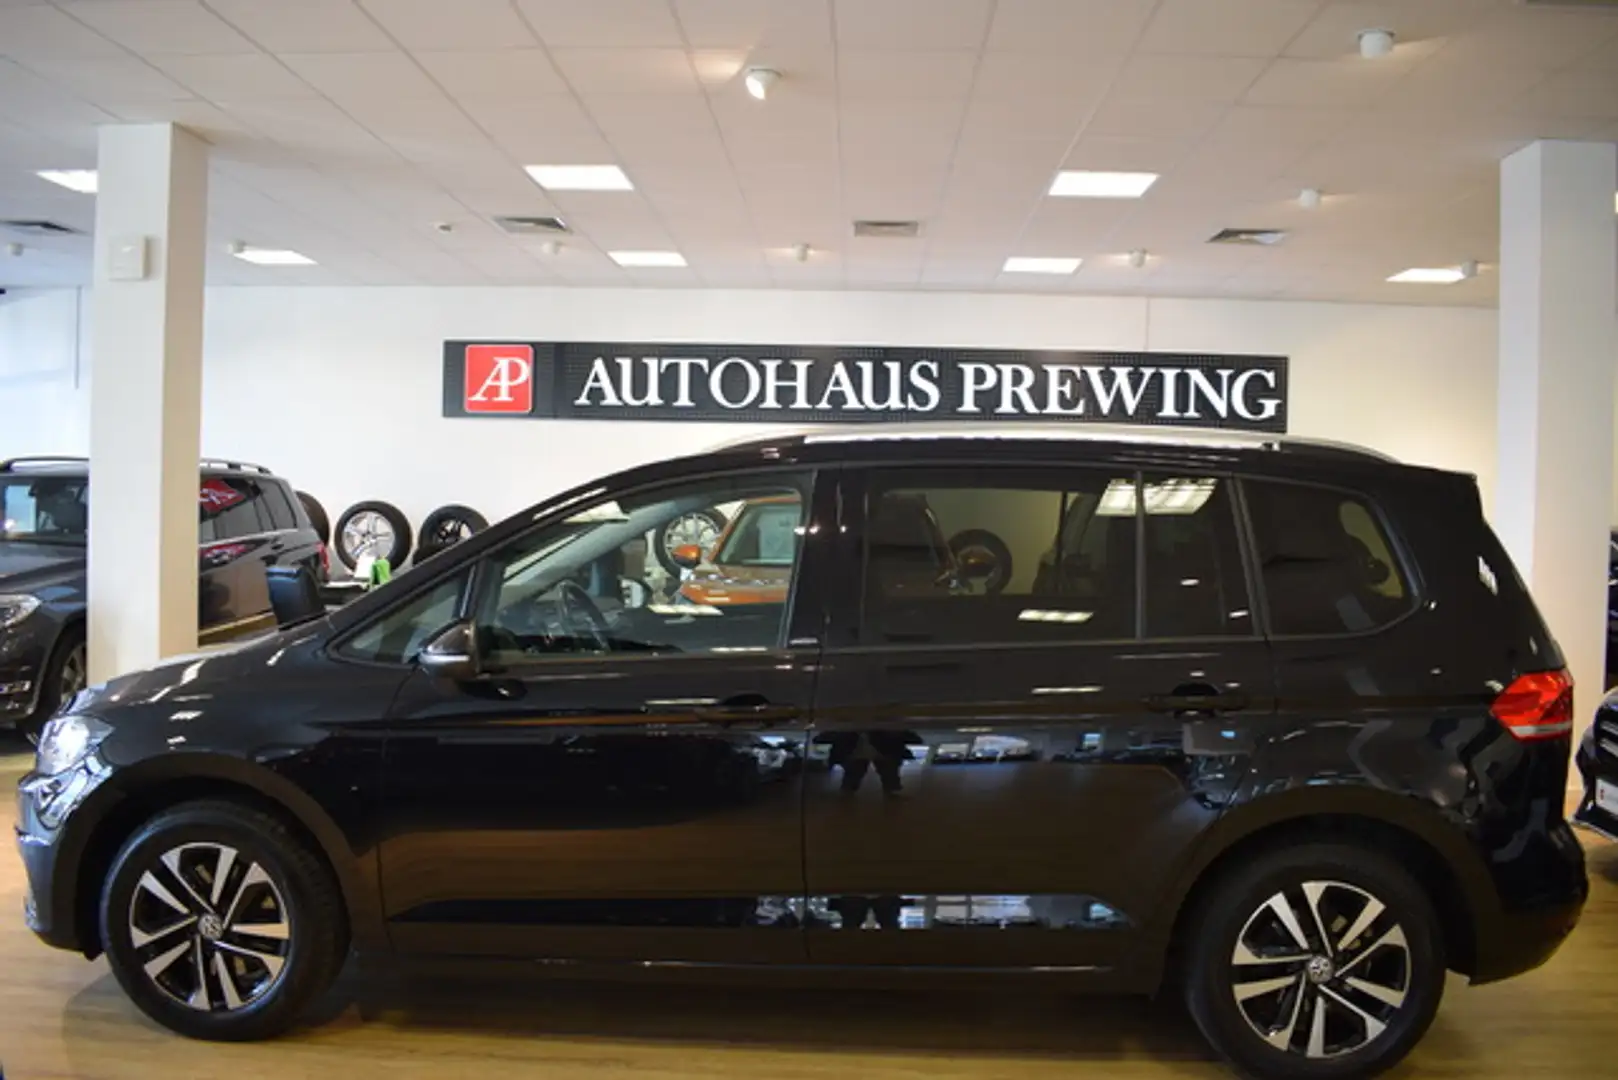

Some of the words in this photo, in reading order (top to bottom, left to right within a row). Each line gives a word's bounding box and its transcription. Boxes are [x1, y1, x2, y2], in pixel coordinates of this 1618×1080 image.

[469, 356, 532, 404] AP
[575, 356, 940, 412] AUTOHAUS
[956, 362, 1282, 420] PREWING
